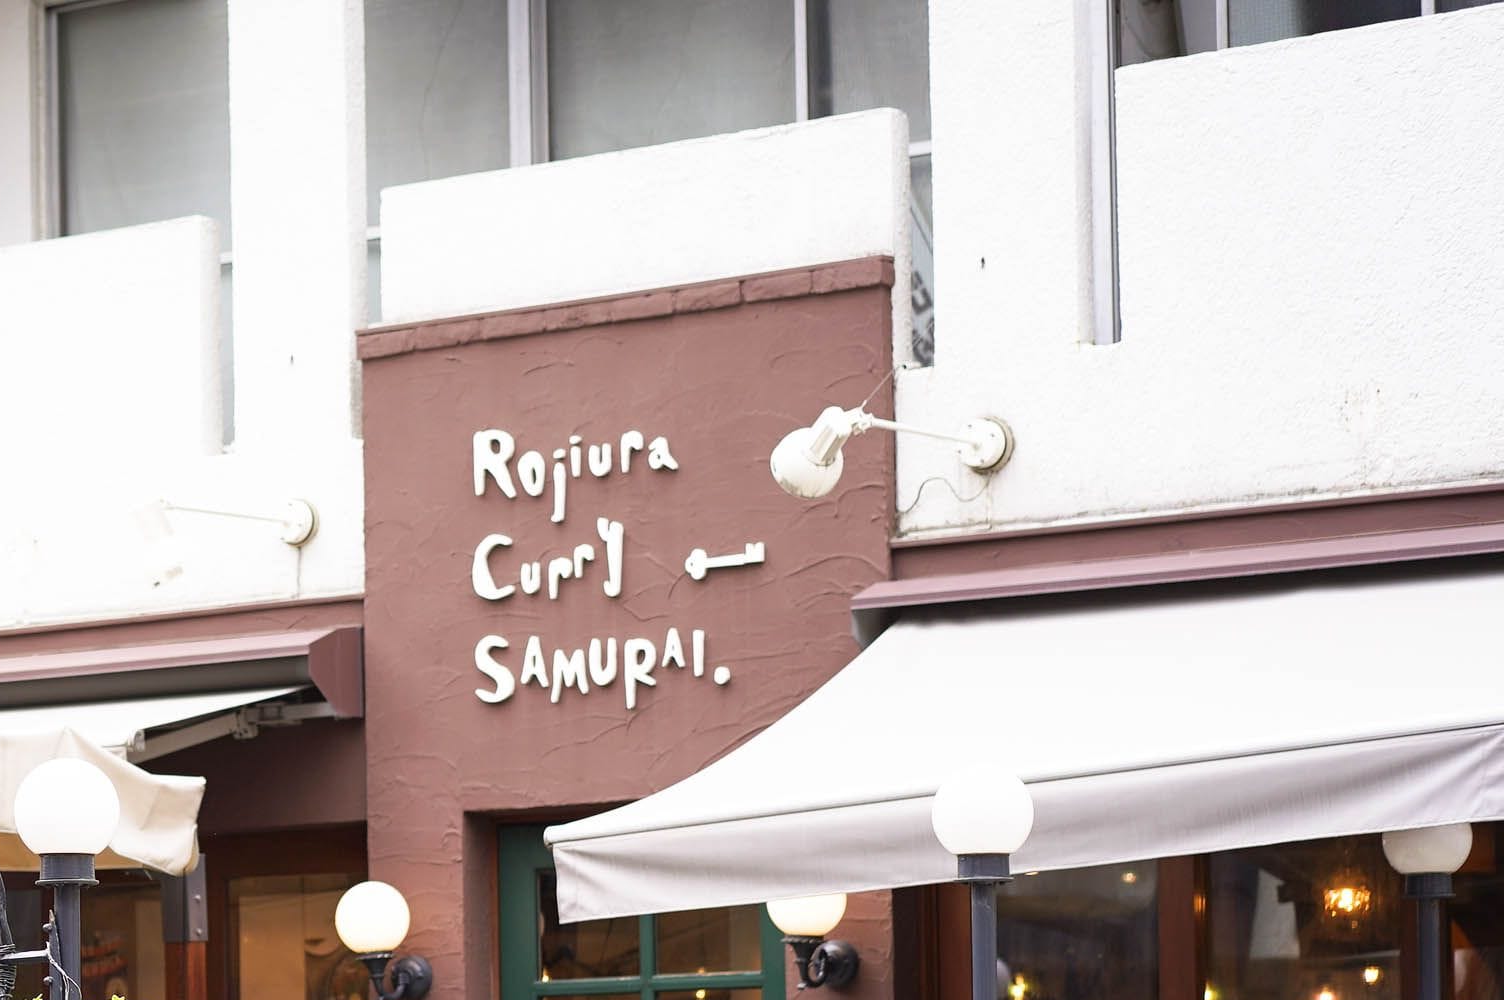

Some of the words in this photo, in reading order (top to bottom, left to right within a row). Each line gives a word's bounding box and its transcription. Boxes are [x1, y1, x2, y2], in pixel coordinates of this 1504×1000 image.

[472, 429, 679, 523] Rojiura
[471, 517, 624, 600] Curry
[474, 627, 731, 709] SAMURAI.
